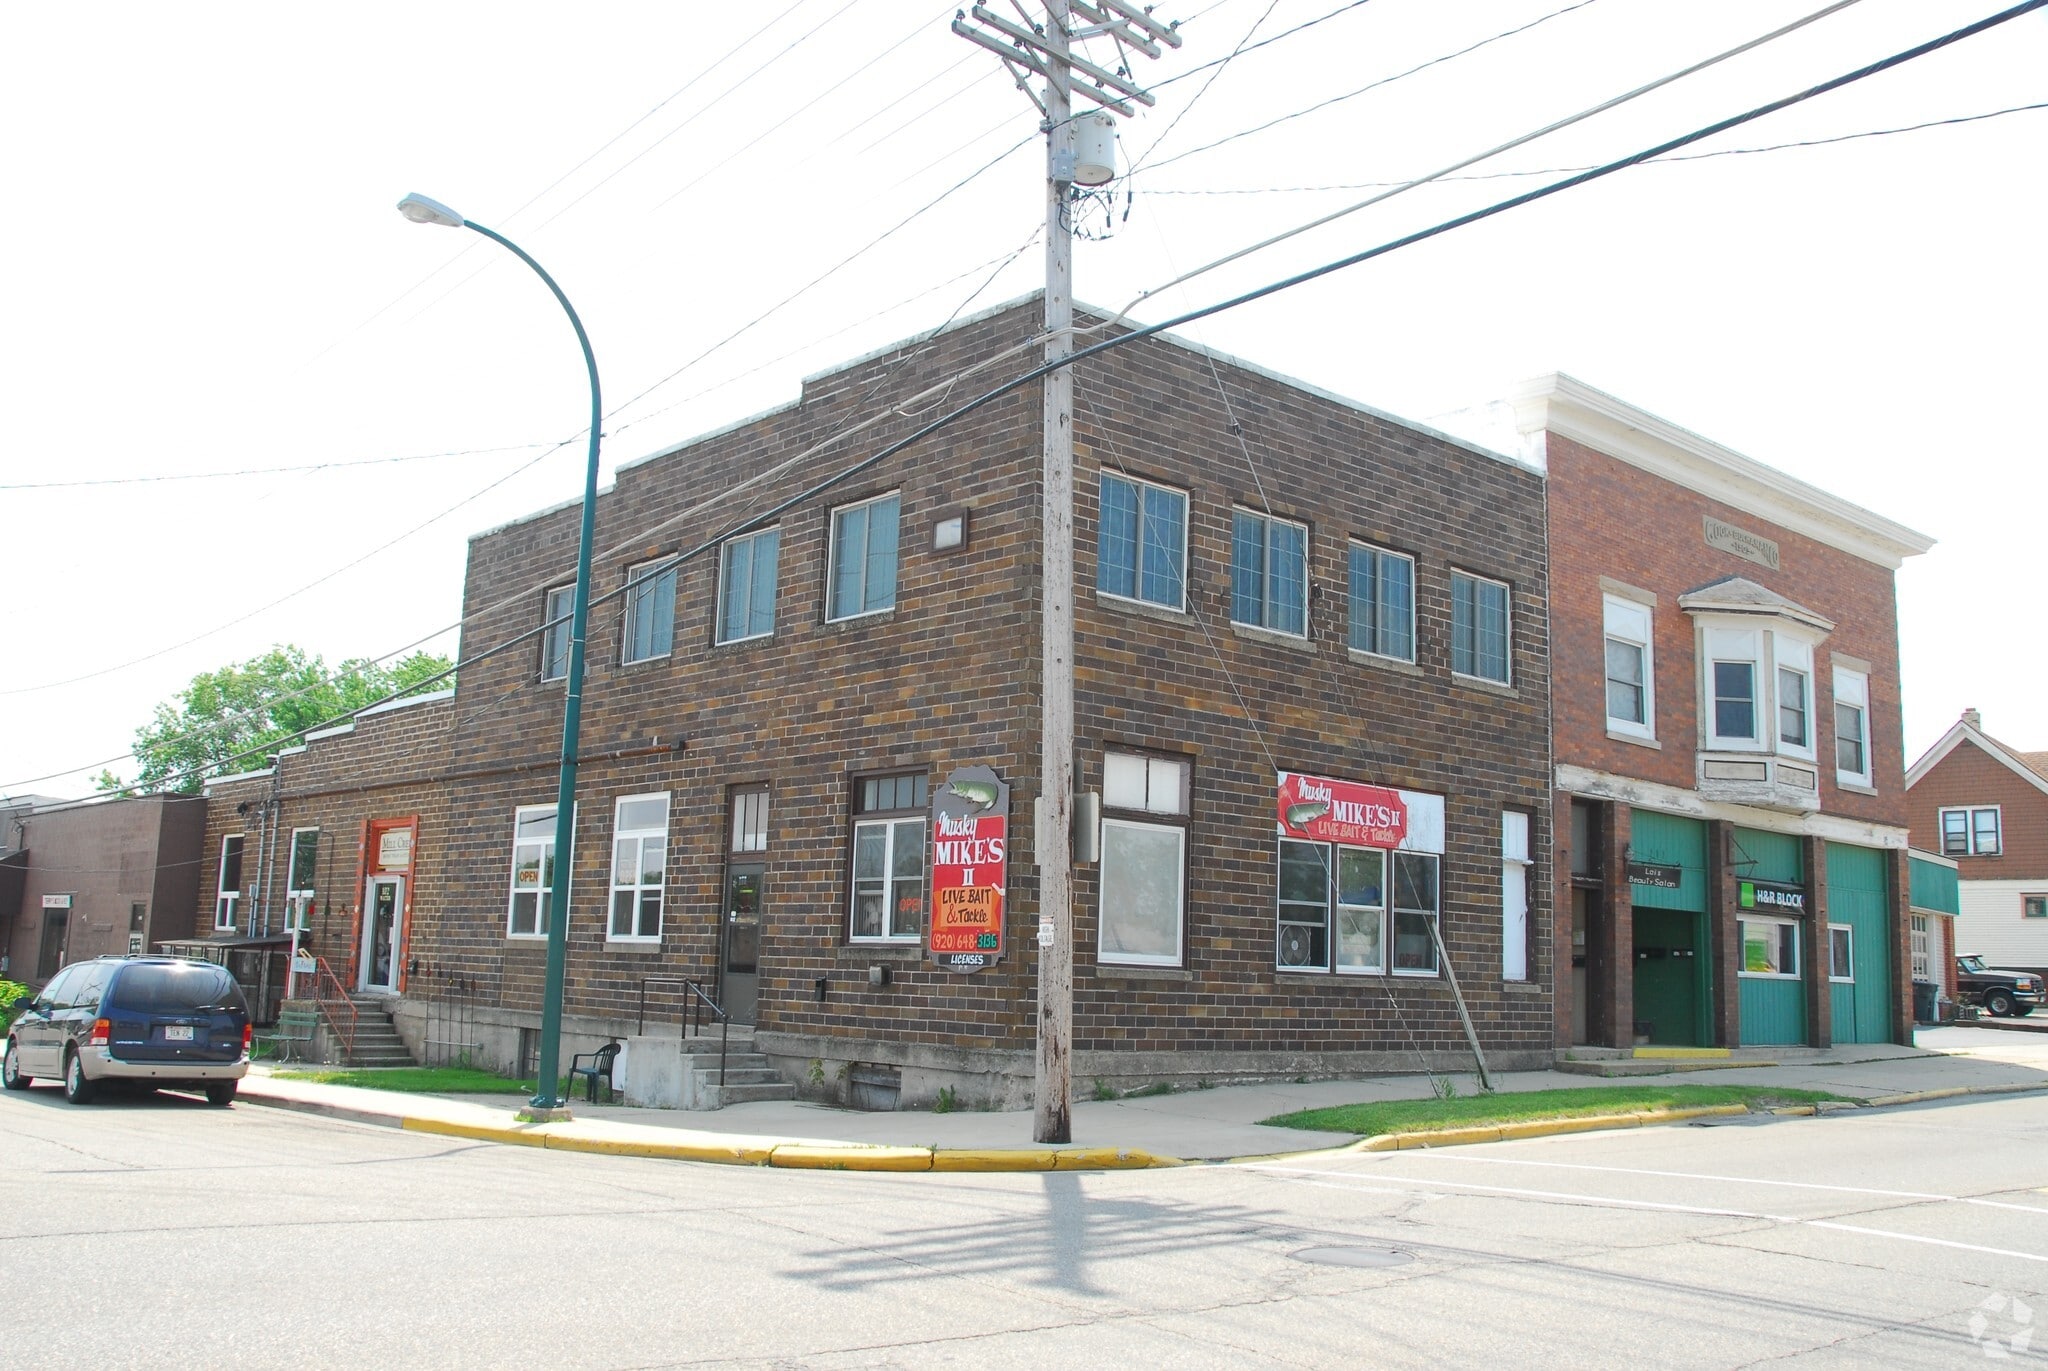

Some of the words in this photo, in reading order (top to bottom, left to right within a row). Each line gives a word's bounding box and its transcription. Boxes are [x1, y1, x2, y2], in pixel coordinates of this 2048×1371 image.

[1297, 777, 1332, 810] Musky
[1332, 800, 1390, 828] MIKE'S
[939, 811, 978, 840] Musky
[1318, 821, 1339, 836] LIVE
[1340, 823, 1361, 839] BAIT
[934, 837, 1004, 866] MIKE'S
[519, 871, 538, 883] OPEN
[962, 868, 975, 886] II
[1654, 878, 1676, 888] Salon
[942, 889, 966, 905] LIVE
[967, 888, 991, 905] BAIT
[1757, 889, 1776, 905] H&R
[1776, 892, 1803, 908] BLOCK
[958, 908, 989, 924] Tackle
[932, 933, 956, 950] (920)
[950, 953, 984, 966] LICENSES
